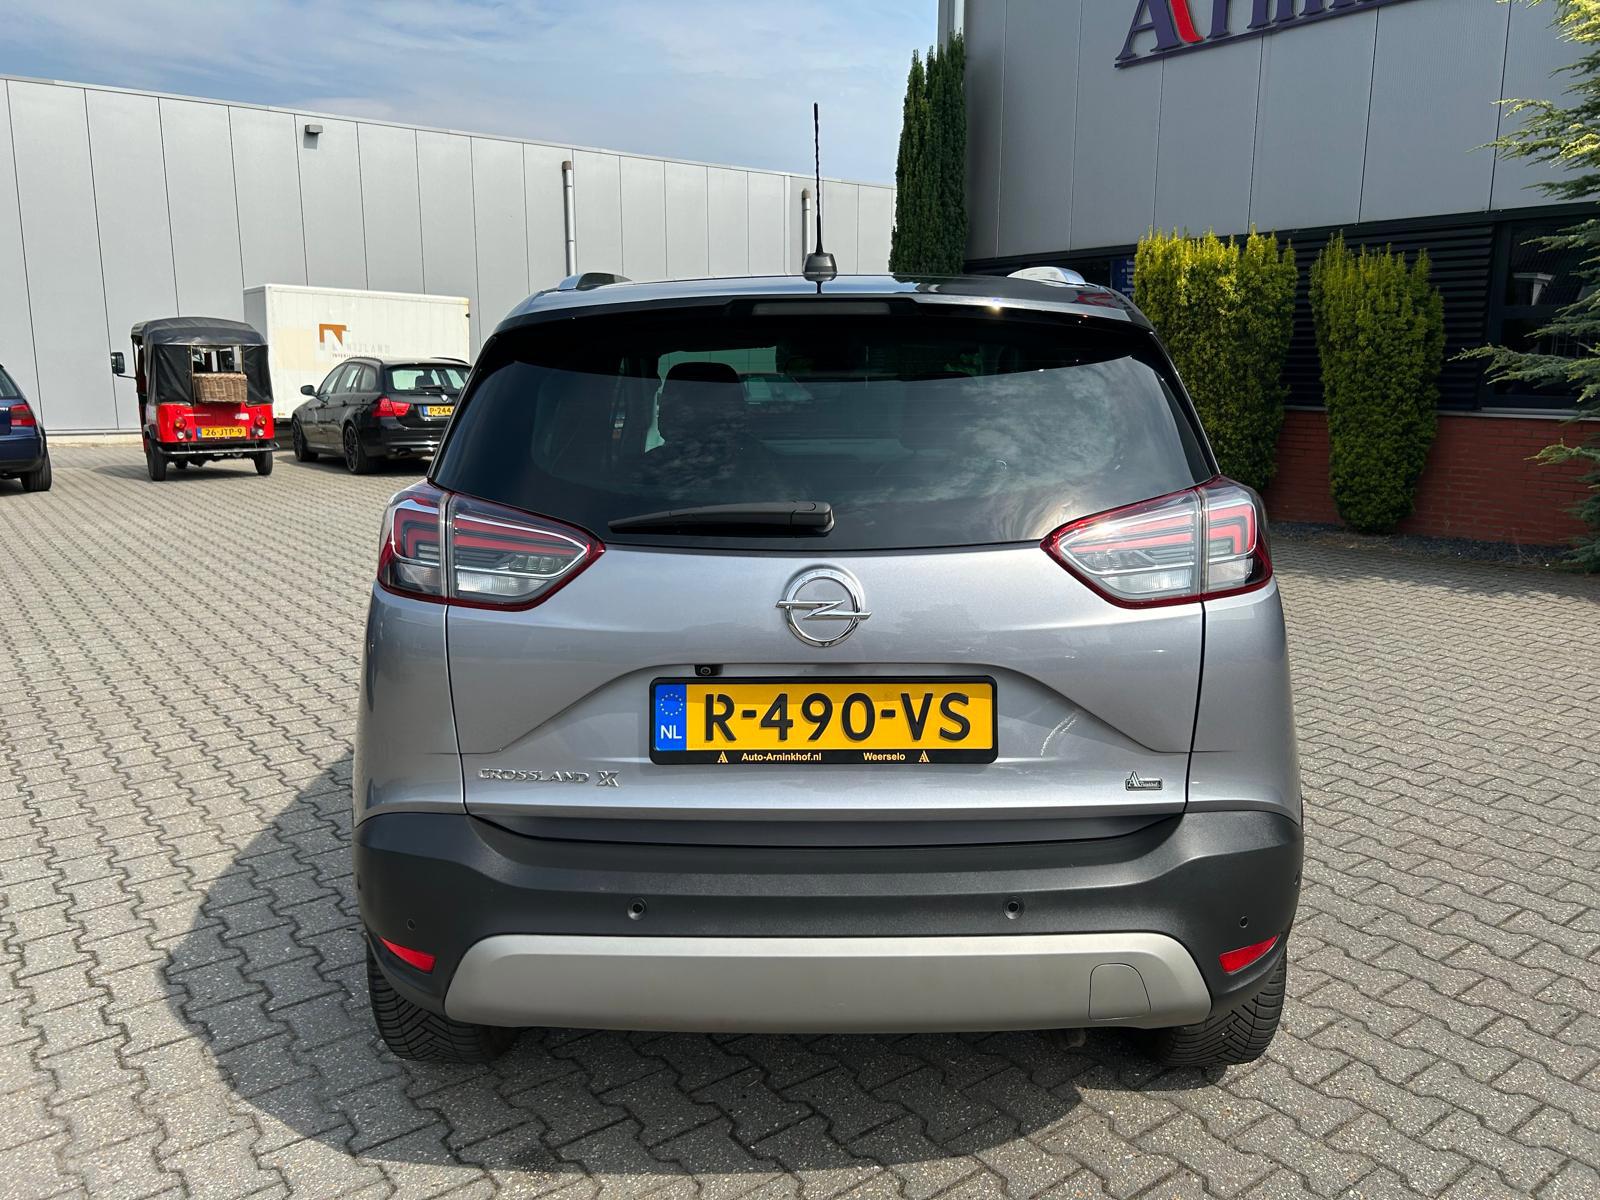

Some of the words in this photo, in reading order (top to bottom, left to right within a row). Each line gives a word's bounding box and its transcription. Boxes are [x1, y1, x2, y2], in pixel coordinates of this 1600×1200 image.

[429, 407, 452, 415] P-244
[704, 692, 971, 742] R-490-VS
[660, 725, 682, 740] NL
[741, 751, 822, 762] Auto-Arninkhof.nl
[863, 751, 906, 761] Weerselo
[478, 768, 590, 783] CROSSLAND
[596, 770, 620, 788] X
